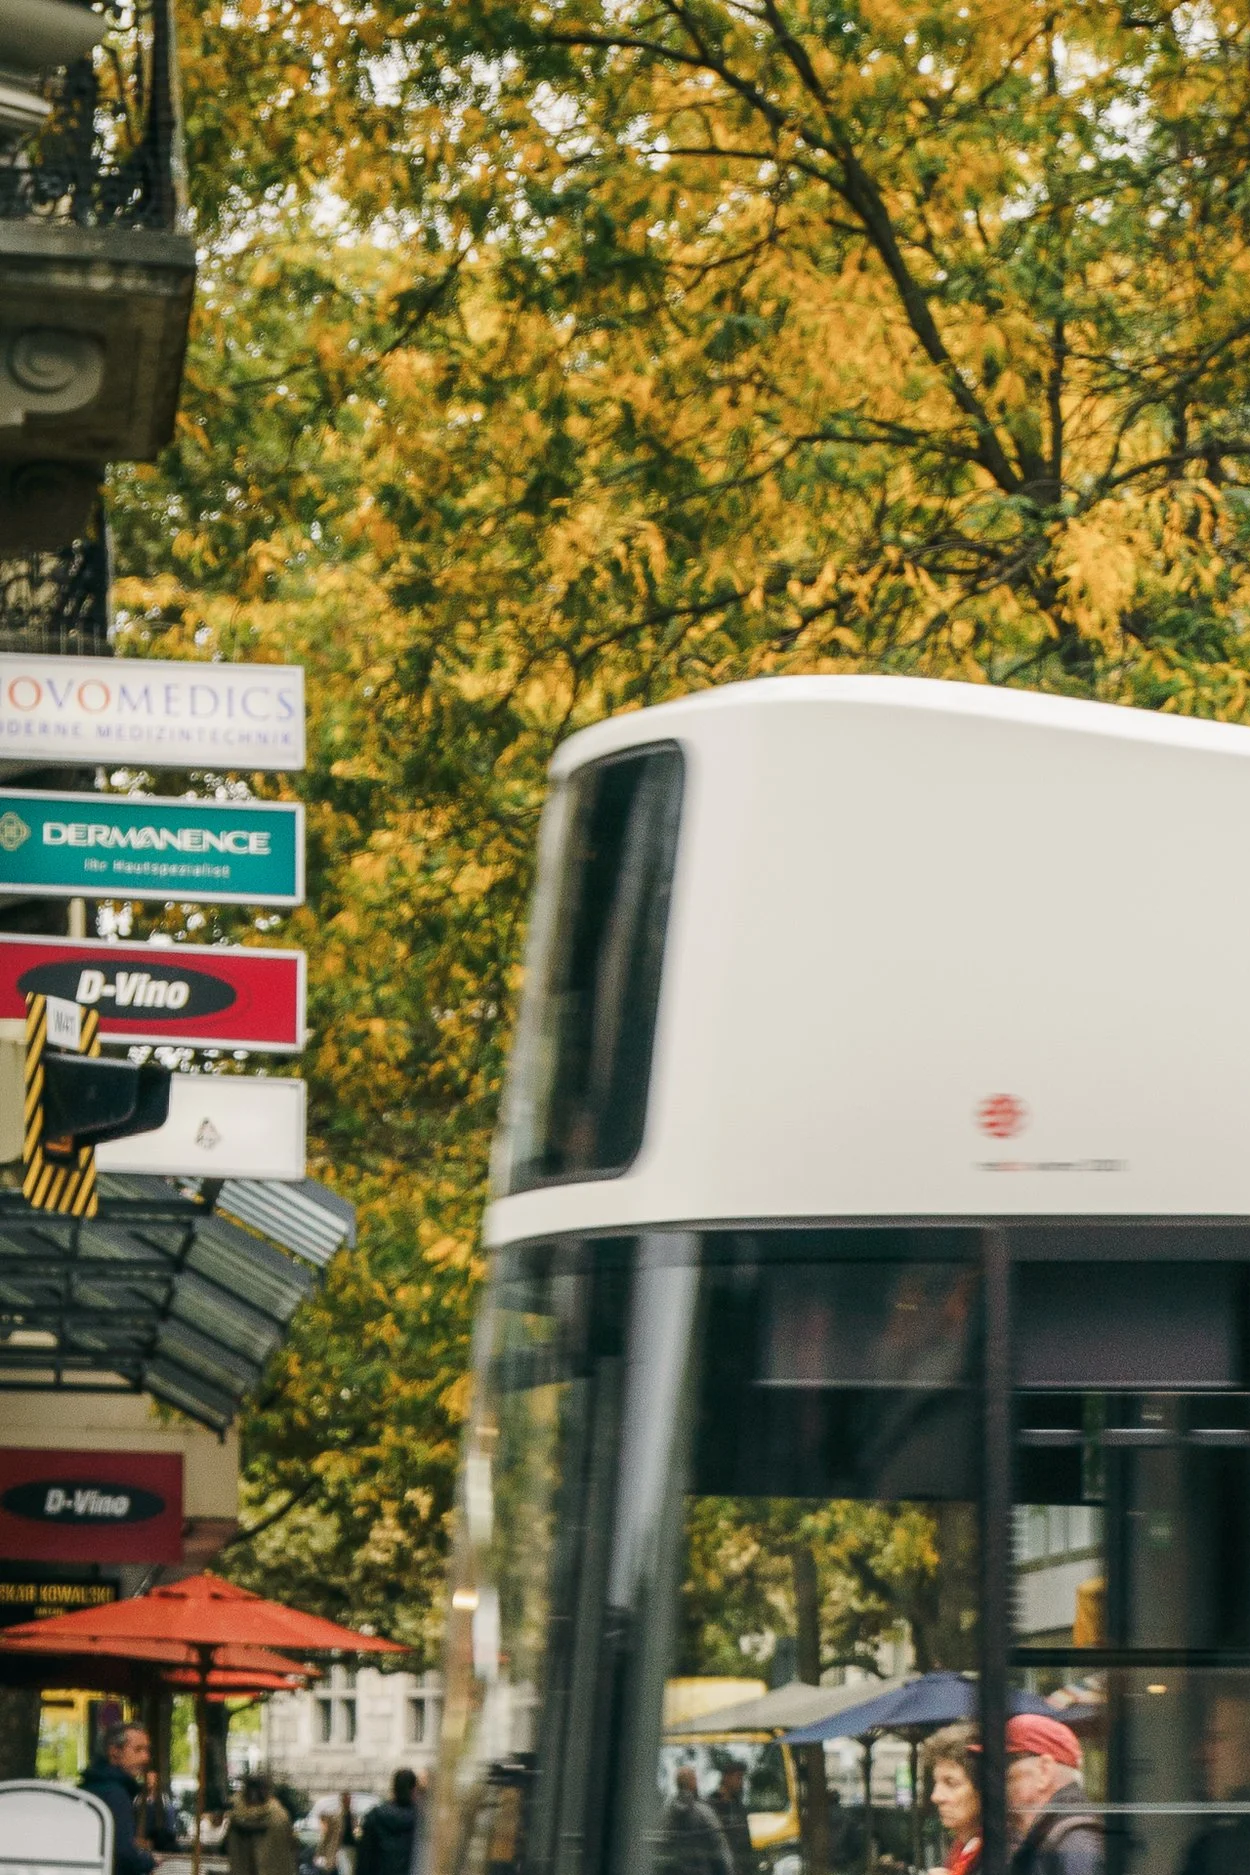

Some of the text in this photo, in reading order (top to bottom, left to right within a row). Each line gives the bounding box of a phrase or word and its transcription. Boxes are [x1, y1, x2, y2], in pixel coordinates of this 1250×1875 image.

[0, 674, 297, 721] OVOMEDICS
[42, 821, 271, 855] DERMANENCE
[76, 969, 190, 1010] D-Vino
[44, 1488, 130, 1519] D-Vino
